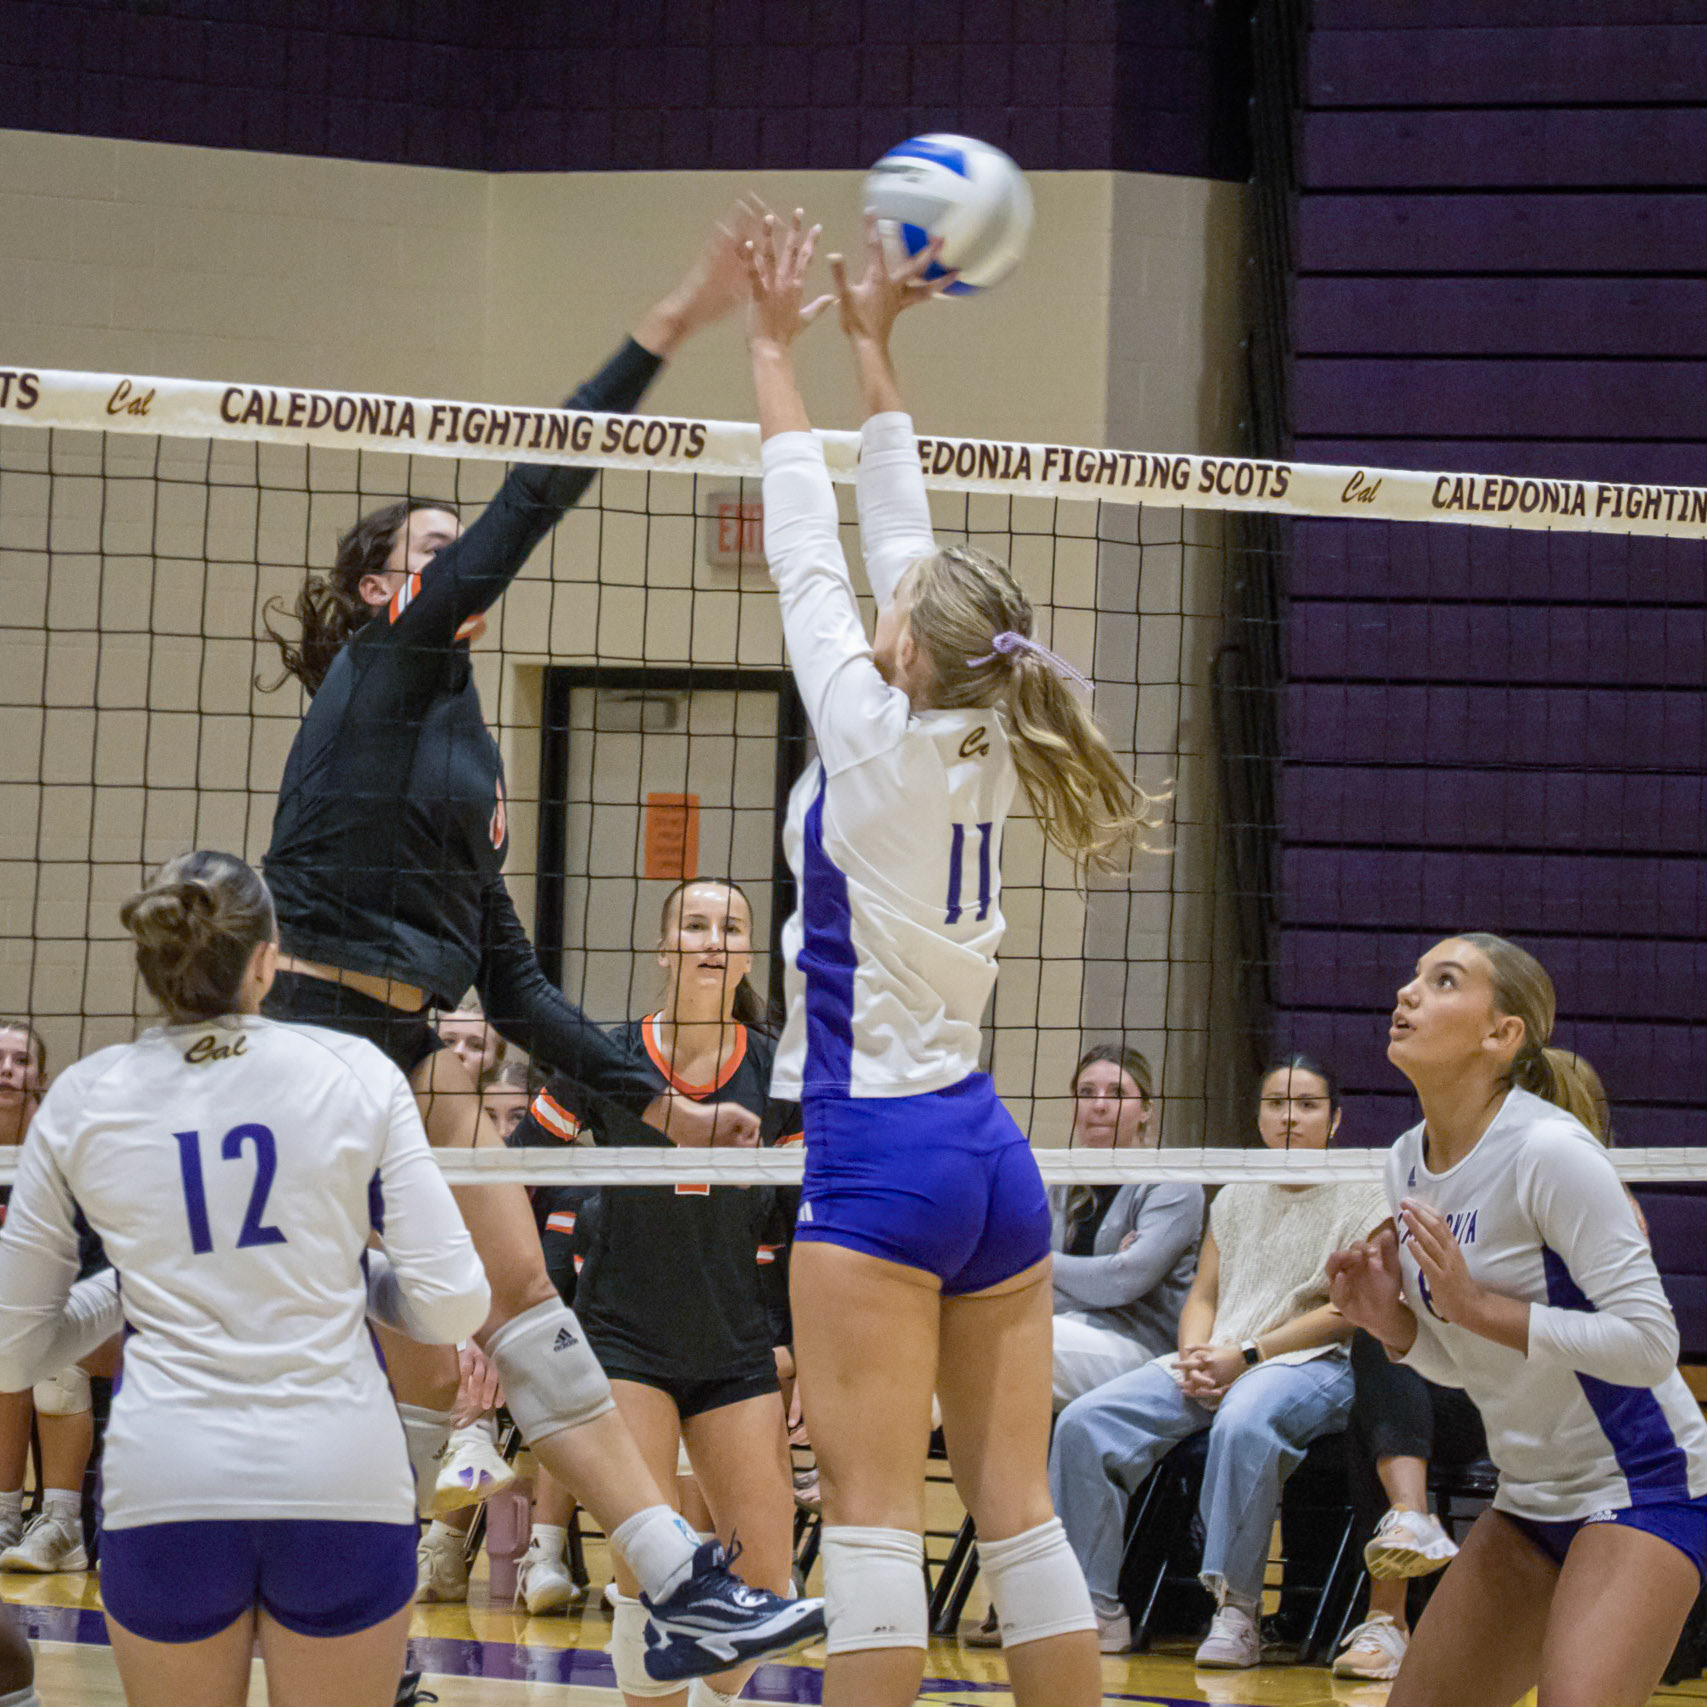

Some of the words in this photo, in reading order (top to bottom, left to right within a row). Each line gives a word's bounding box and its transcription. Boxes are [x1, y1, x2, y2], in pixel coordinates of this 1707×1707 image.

[106, 379, 156, 417] Cal
[220, 387, 416, 439] CALEDONIA
[428, 406, 594, 451] FIGHTING
[601, 418, 707, 458] SCOTS
[918, 439, 1031, 481] EDONIA
[1042, 448, 1190, 490] FIGHTING
[1198, 460, 1292, 498] SCOTS
[1341, 470, 1382, 504] Cal
[1431, 475, 1586, 517] CALEDONIA
[944, 822, 993, 924] 11
[183, 1034, 248, 1064] Cal
[171, 1123, 288, 1255] 12
